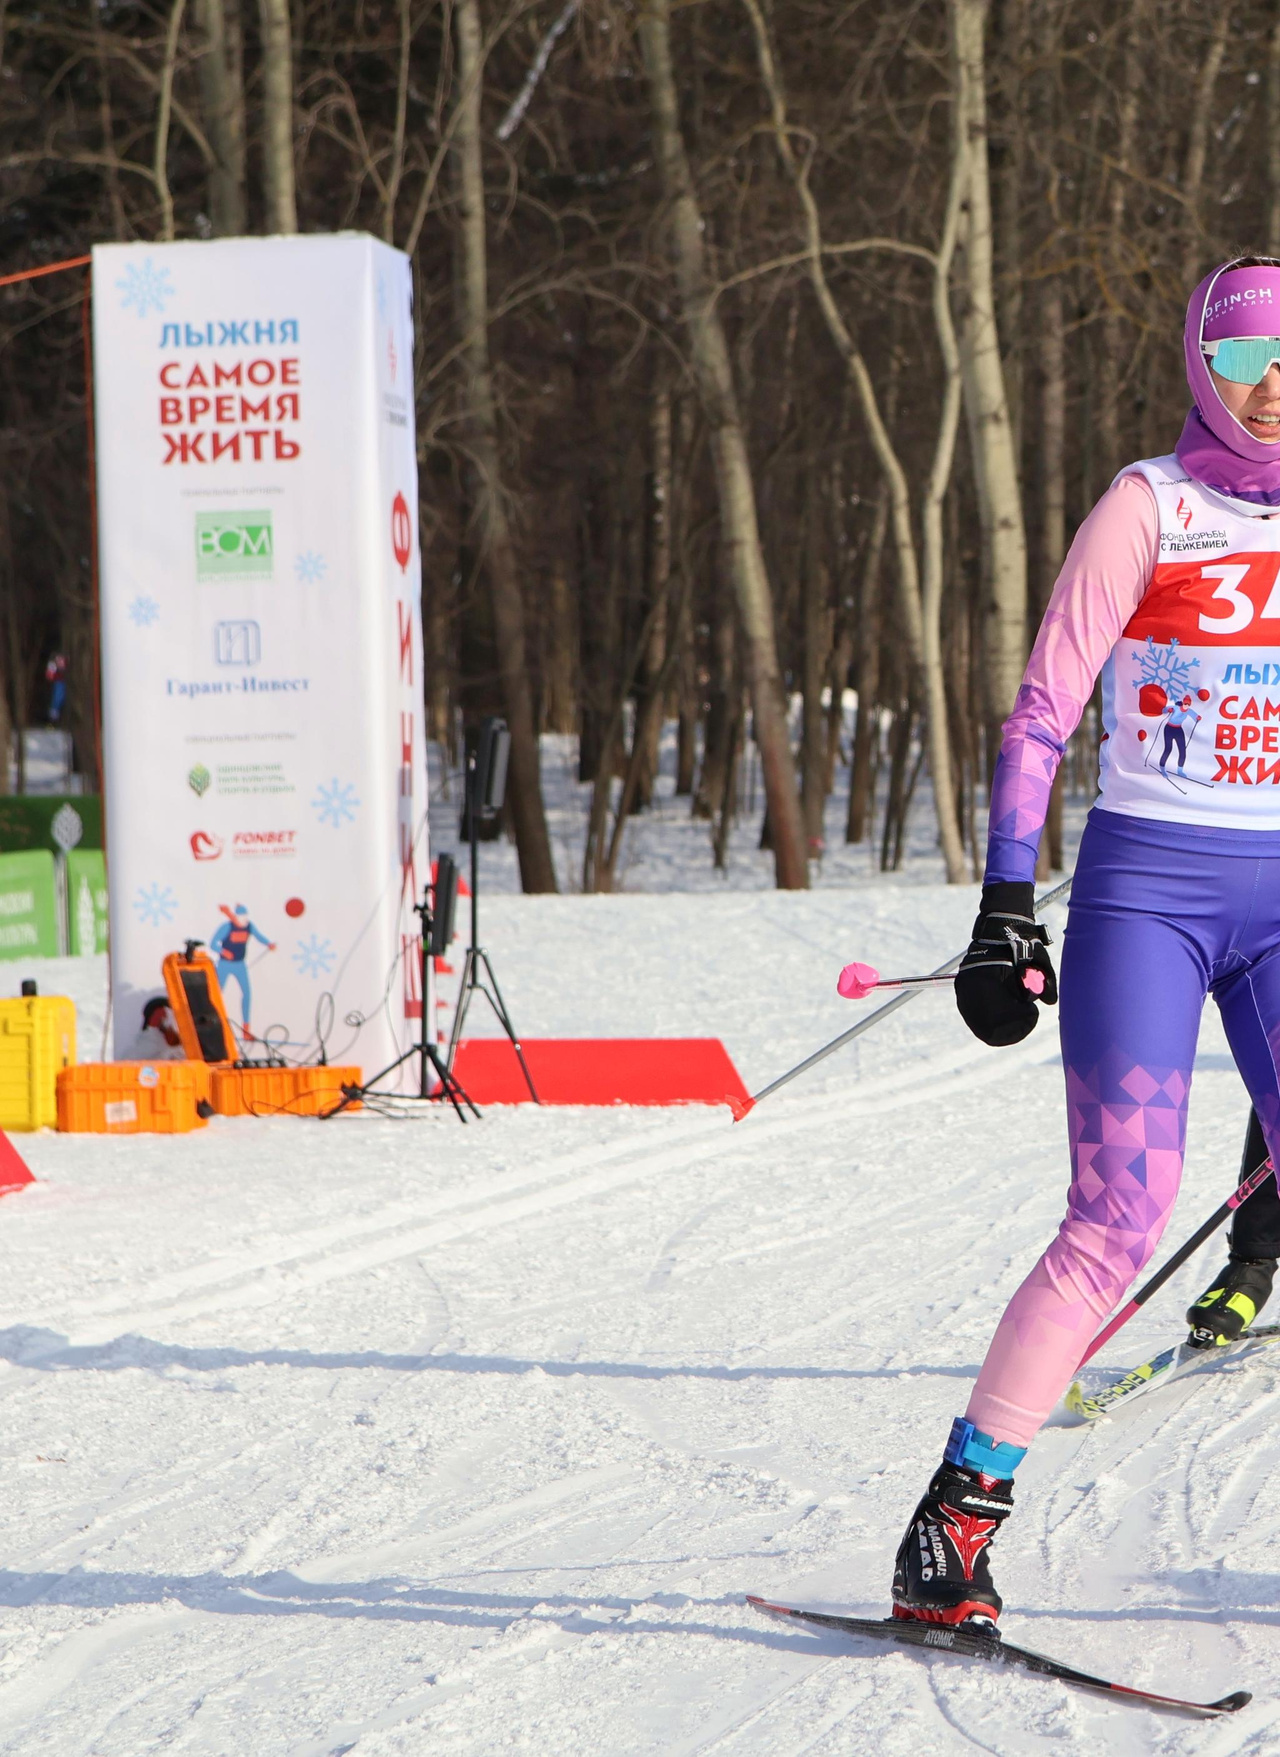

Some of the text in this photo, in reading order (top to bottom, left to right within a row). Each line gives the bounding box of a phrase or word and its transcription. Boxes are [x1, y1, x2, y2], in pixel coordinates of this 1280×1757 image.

[159, 319, 299, 348] ЛЫЖНЯ
[159, 358, 300, 390] САМОЕ
[159, 393, 299, 425] ВРЕМЯ
[162, 429, 302, 465] ЖИТЬ
[1160, 529, 1227, 545] ФОНД БОРЬБЫ
[1160, 542, 1167, 552] С
[166, 677, 310, 698] Гарант-Инвест
[232, 831, 297, 844] FONBET
[927, 1524, 947, 1578] MADSHUS
[923, 1630, 955, 1647] ATOMIC
